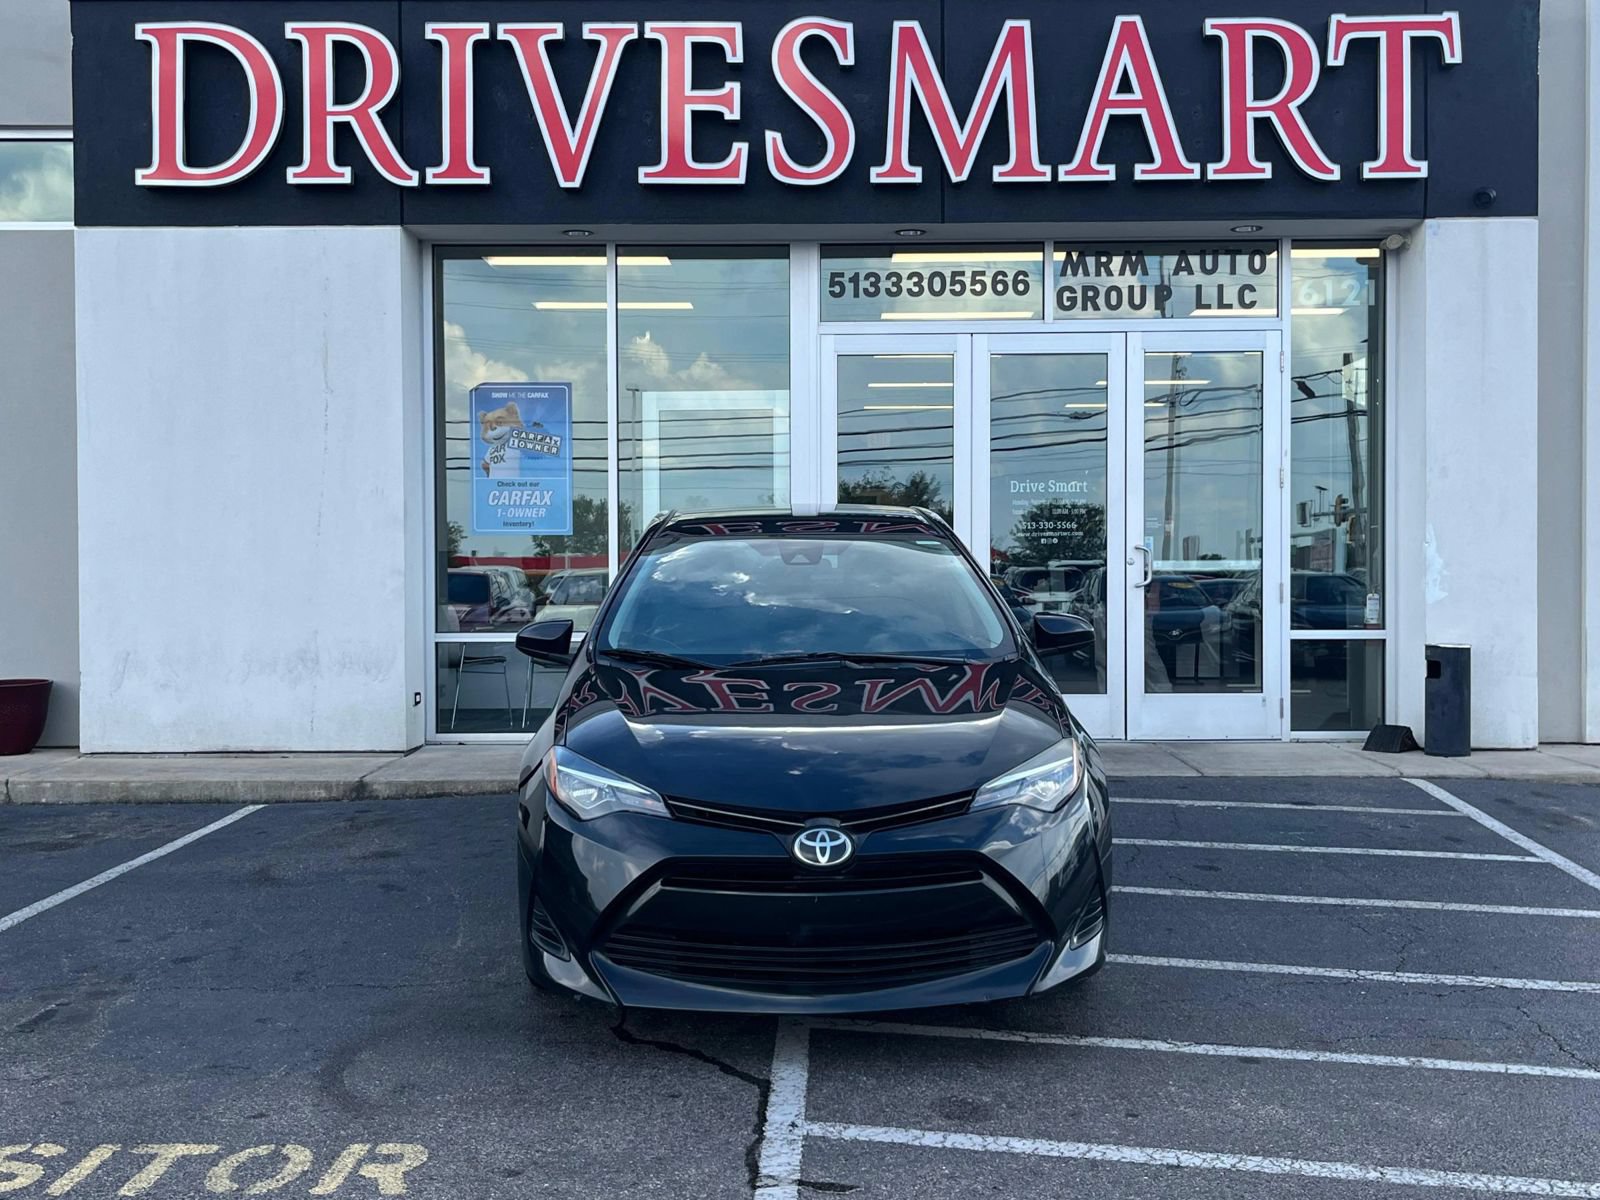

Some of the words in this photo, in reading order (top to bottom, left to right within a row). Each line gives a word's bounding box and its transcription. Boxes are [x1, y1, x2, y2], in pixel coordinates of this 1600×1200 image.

[134, 11, 1463, 189] DRIVESMART
[1060, 250, 1149, 277] MRM
[1172, 250, 1267, 276] AUTO
[827, 270, 1031, 298] 5133305566
[1056, 284, 1173, 312] GROUP
[1195, 283, 1258, 310] LLC
[512, 430, 561, 446] CARFAX
[489, 443, 506, 456] CAR
[519, 441, 558, 455] OWNER
[489, 454, 506, 464] FOX
[1010, 480, 1045, 492] Drive
[1048, 480, 1088, 492] Smart
[488, 490, 553, 505] CARFAX
[497, 507, 546, 518] 1-OWNER
[1022, 521, 1077, 530] 513-330-5566
[0, 1143, 429, 1196] SITOR
